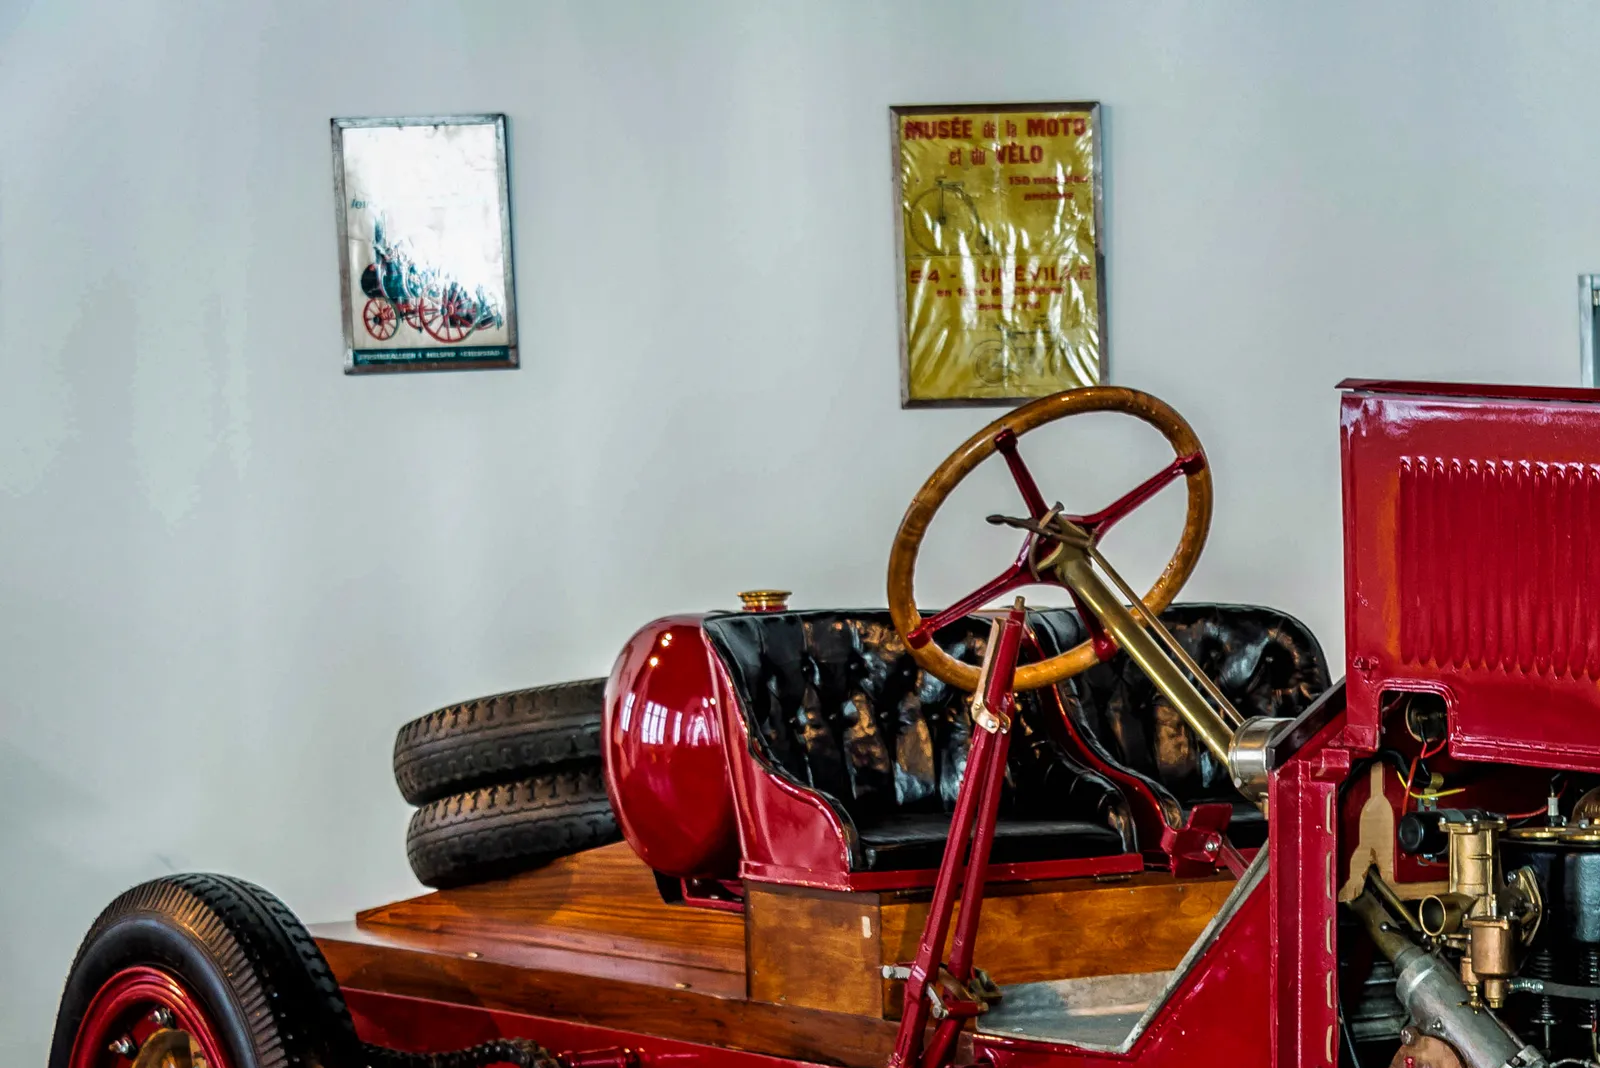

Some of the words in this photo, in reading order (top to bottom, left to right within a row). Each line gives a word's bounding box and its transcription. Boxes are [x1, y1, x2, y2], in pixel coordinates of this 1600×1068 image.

[904, 116, 973, 140] MUSÉE
[983, 120, 996, 139] de
[1006, 120, 1018, 139] la
[1027, 117, 1086, 138] MOTO
[949, 147, 962, 166] et
[972, 145, 985, 166] du
